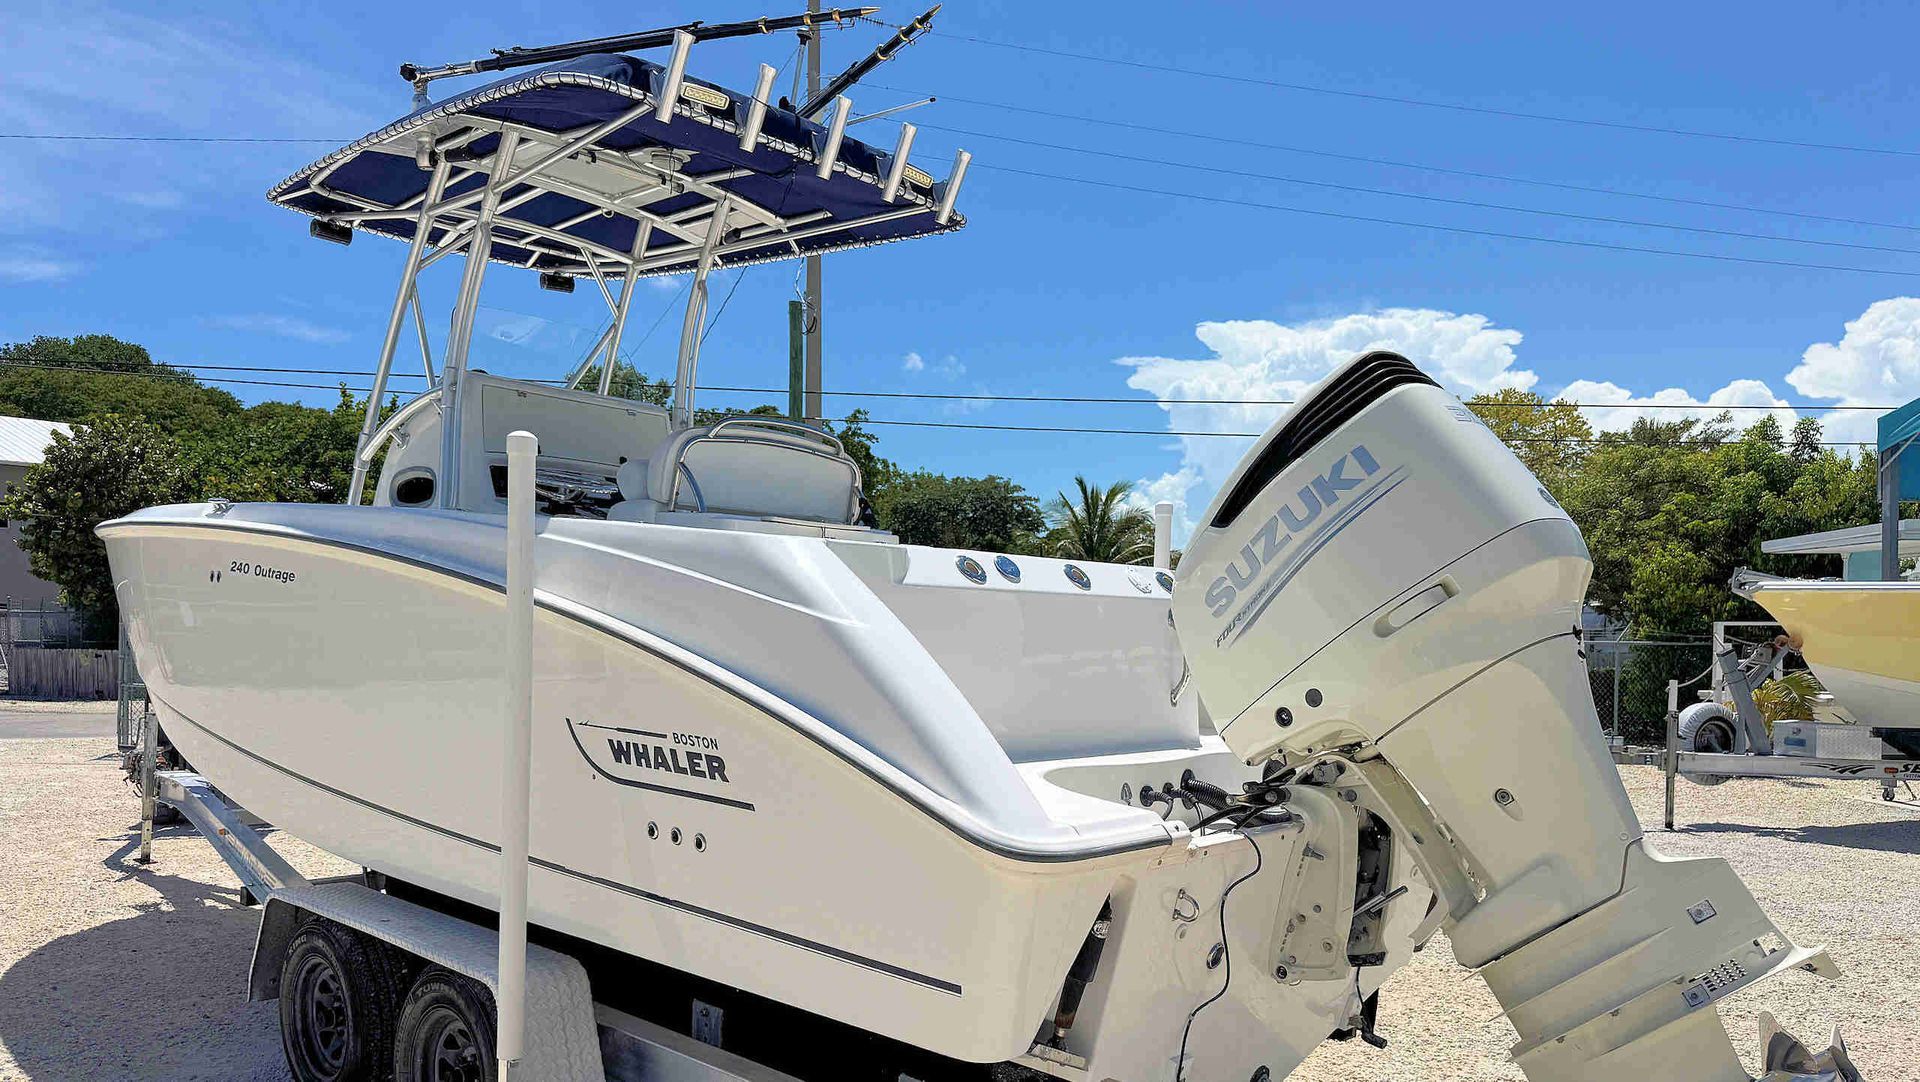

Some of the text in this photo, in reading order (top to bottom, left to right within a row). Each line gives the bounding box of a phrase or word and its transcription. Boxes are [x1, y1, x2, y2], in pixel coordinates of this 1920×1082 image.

[1204, 444, 1381, 618] SUZUKI
[230, 561, 296, 584] 240 Outrage
[672, 732, 719, 750] BOSTON
[607, 738, 730, 783] WHALER
